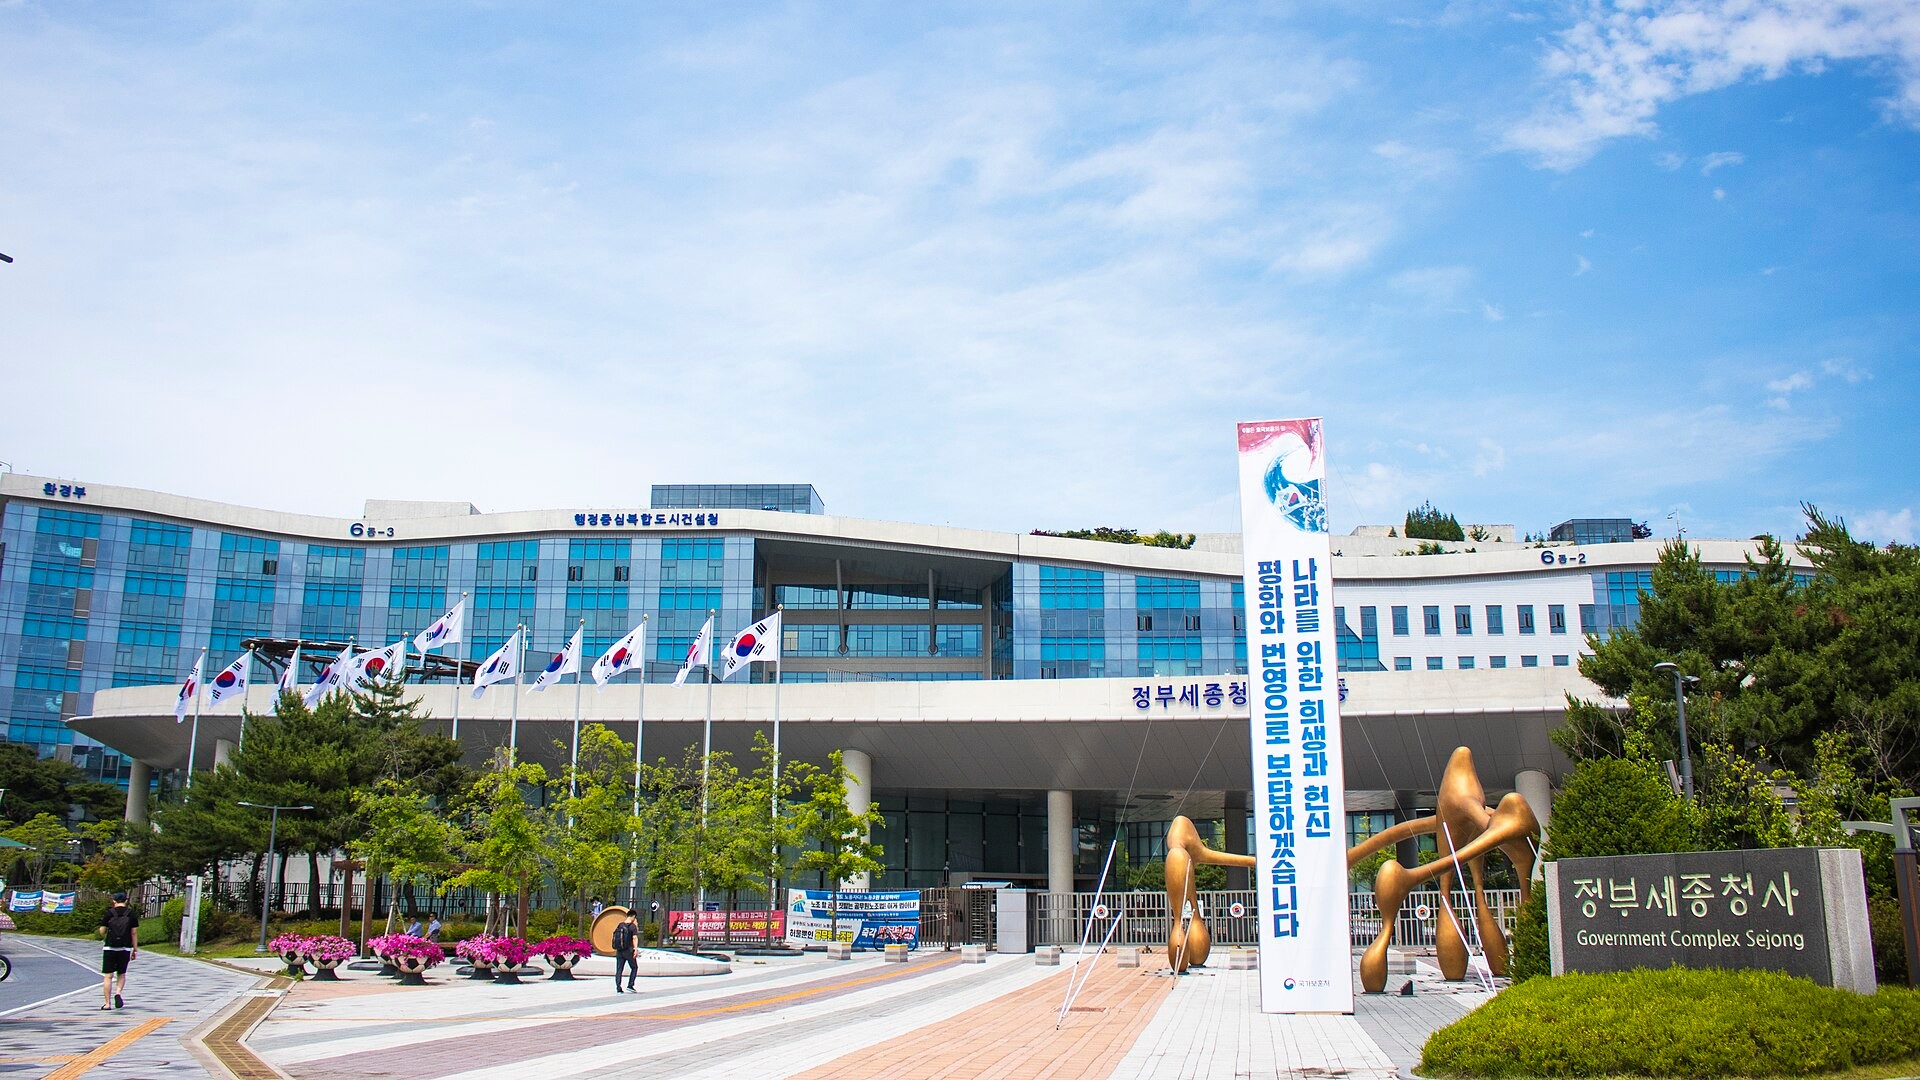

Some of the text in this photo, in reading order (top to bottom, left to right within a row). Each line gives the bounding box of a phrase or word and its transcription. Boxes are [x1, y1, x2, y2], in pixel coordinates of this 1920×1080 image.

[43, 482, 86, 498] 환경부
[574, 513, 719, 526] 행정중심복합도시건설청
[1132, 681, 1247, 709] 정부세종청
[1292, 557, 1331, 838] 나라를 위한 희생과 헌신
[1257, 560, 1300, 938] 평화와 번영으로 보답하겠습니다
[1573, 871, 1800, 918] 정부세종청사
[1577, 929, 1805, 951] Government Complex Sejong
